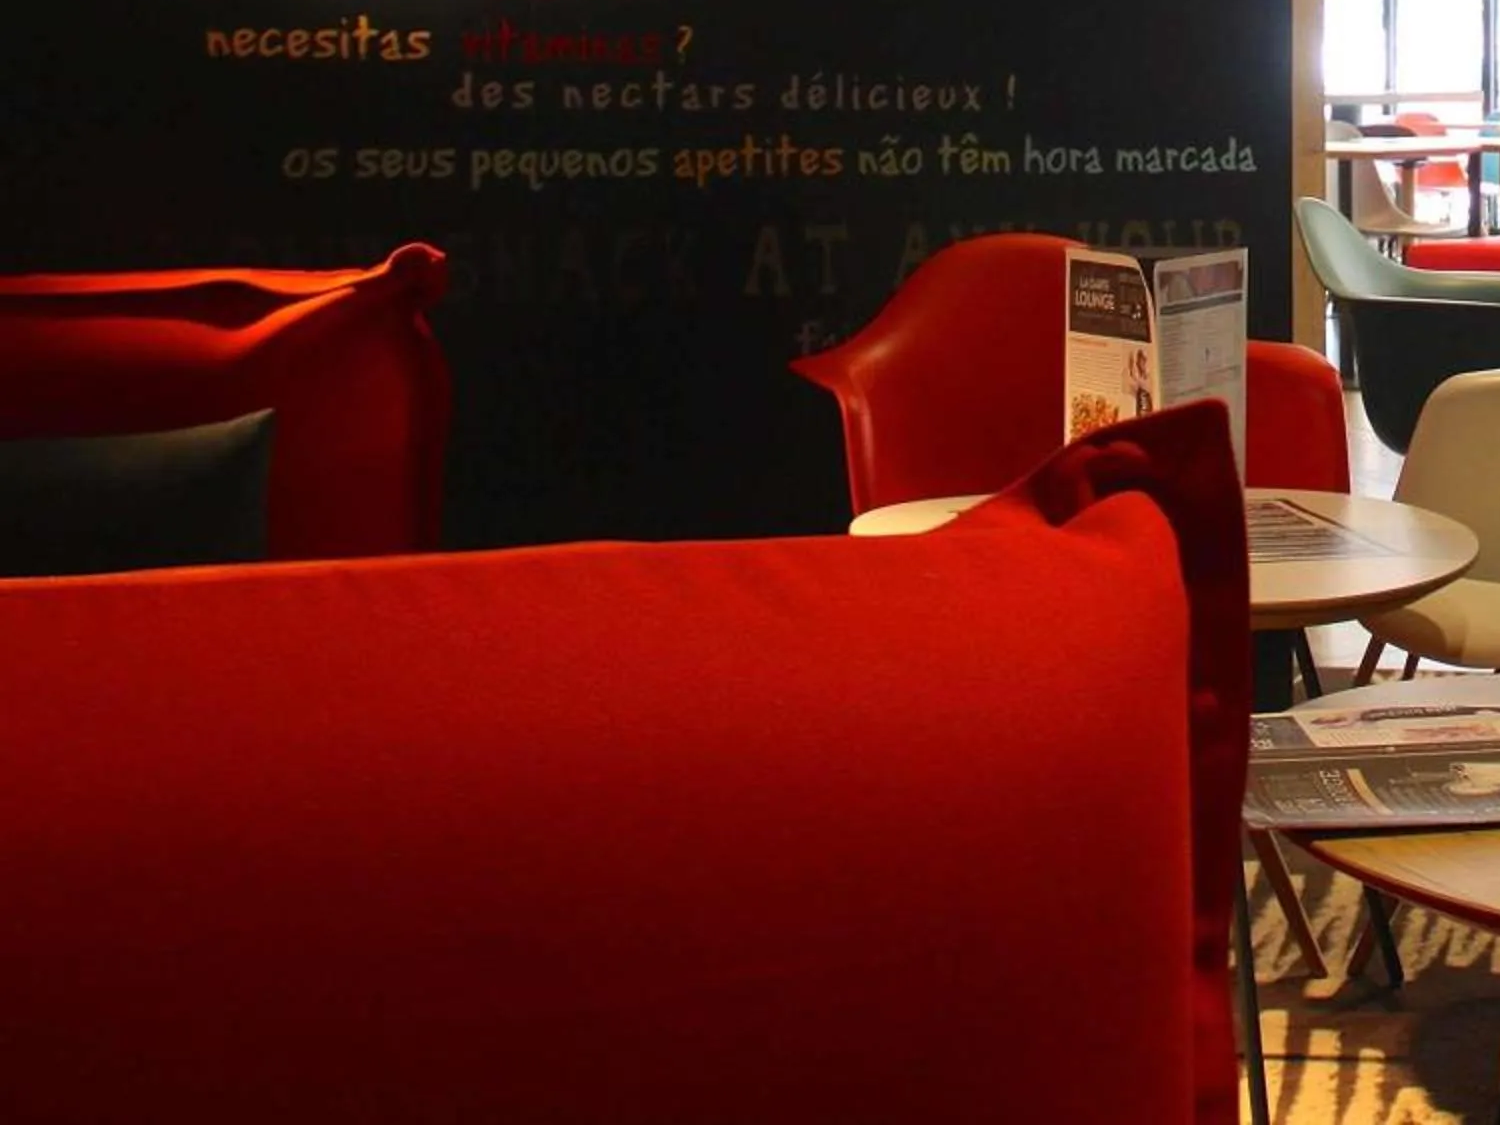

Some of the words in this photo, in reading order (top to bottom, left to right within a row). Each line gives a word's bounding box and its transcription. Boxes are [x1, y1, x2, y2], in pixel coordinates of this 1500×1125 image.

[206, 15, 431, 61] necesitas
[452, 71, 535, 109] des
[562, 71, 755, 112] nectars
[781, 69, 981, 112] délicieux
[281, 147, 339, 179] os
[354, 147, 456, 179] seus
[470, 147, 659, 192] pequenos
[673, 133, 844, 188] apetites
[858, 134, 923, 175] não
[938, 132, 1010, 174] têm
[1023, 132, 1103, 174] hora
[1116, 135, 1257, 175] marcada
[742, 220, 848, 299] AT
